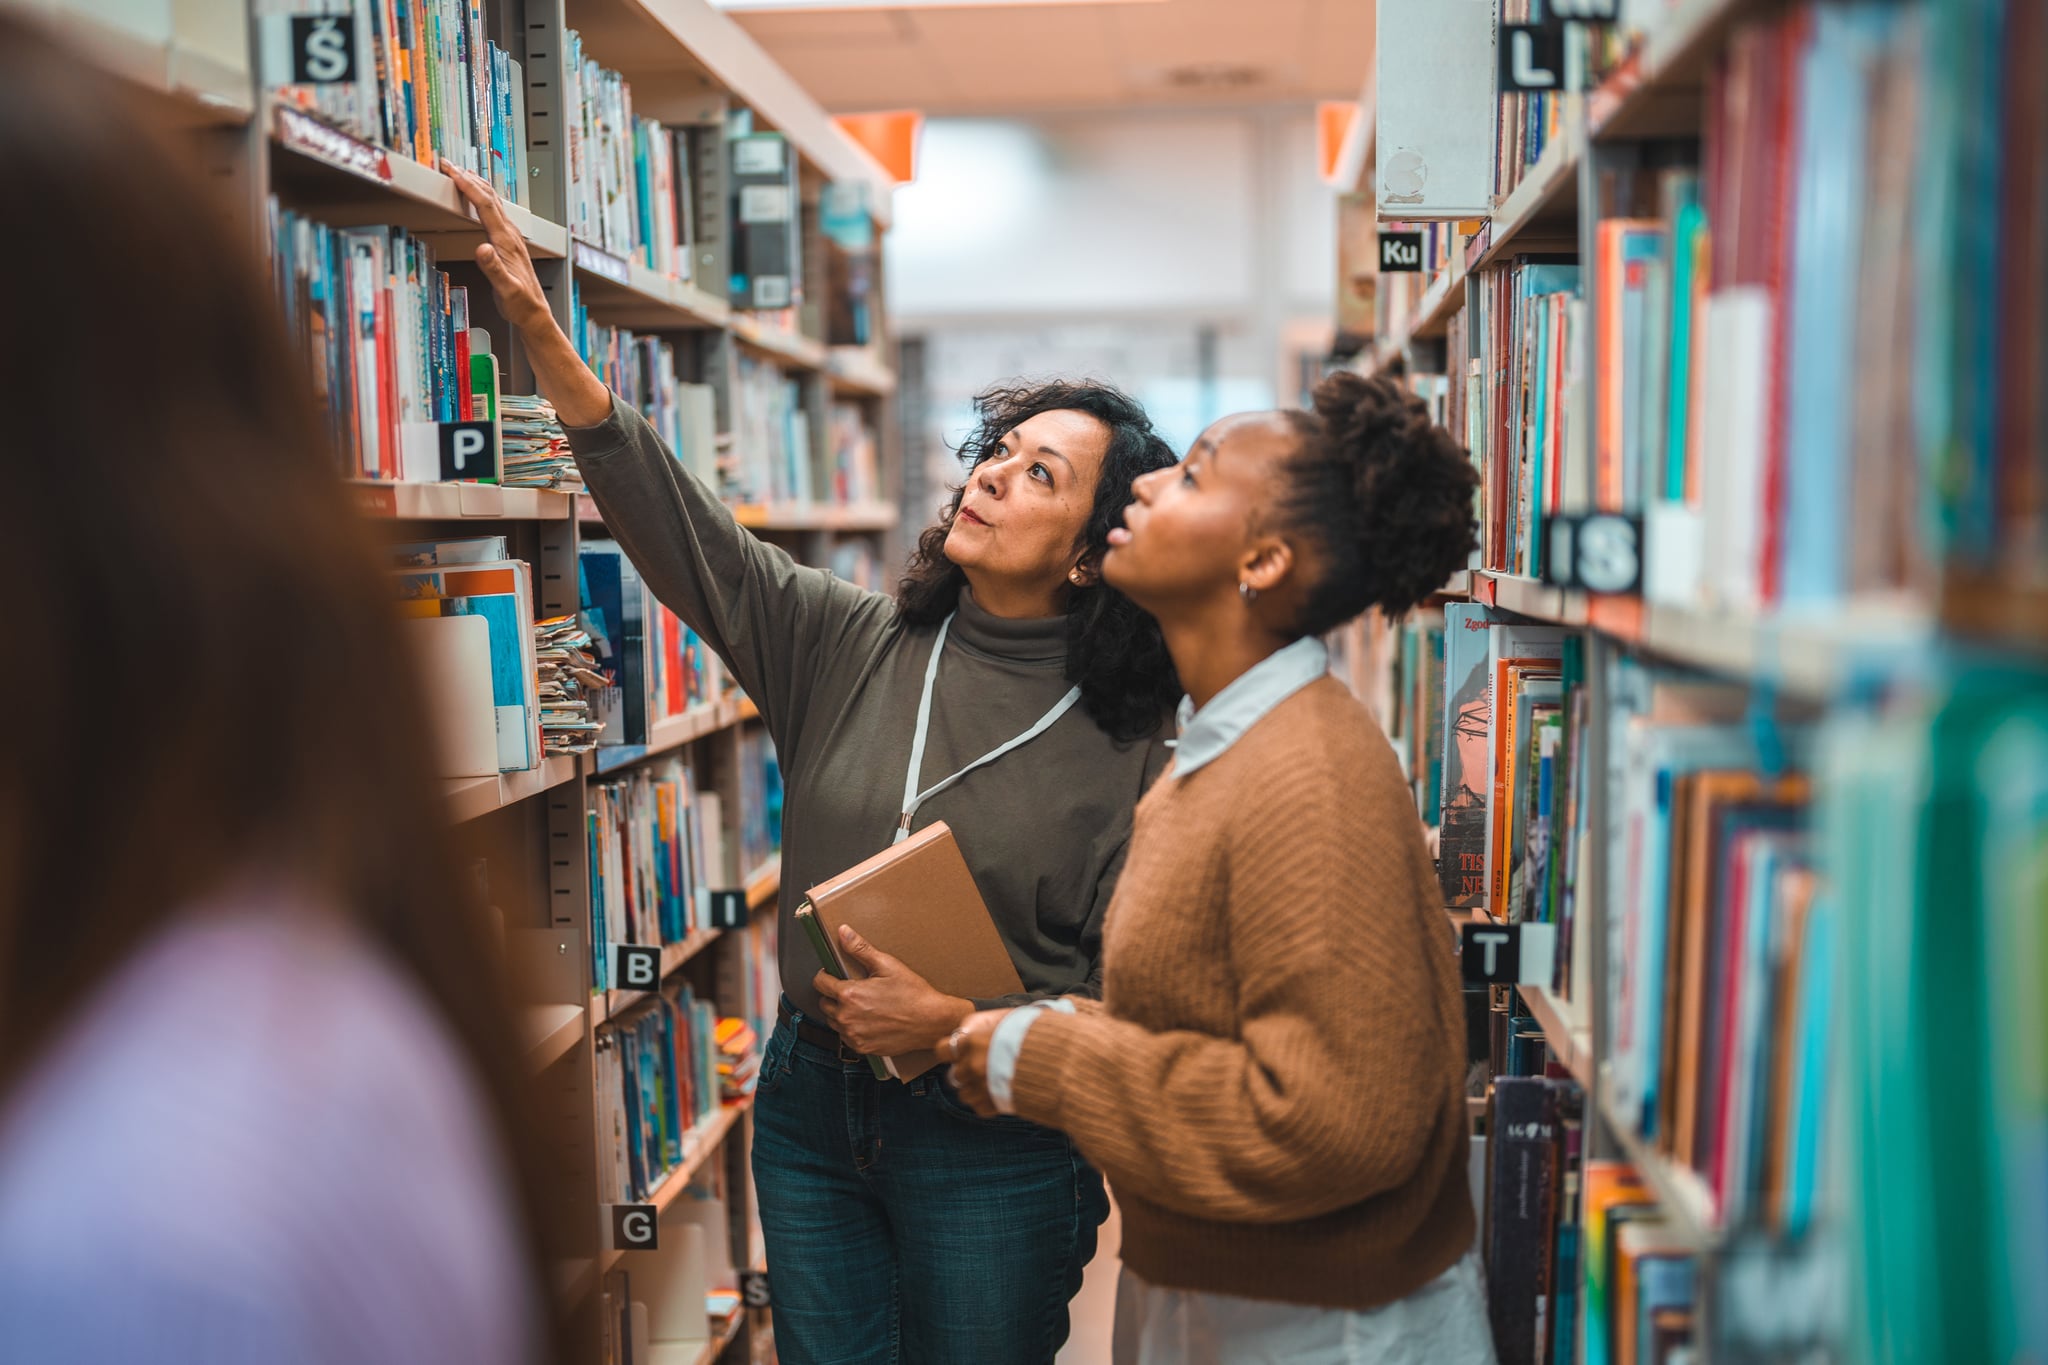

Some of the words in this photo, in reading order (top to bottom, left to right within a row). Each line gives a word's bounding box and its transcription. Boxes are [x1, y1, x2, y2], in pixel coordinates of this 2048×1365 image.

[304, 18, 348, 80] Š
[1511, 29, 1556, 88] L
[1383, 239, 1418, 265] Ku
[453, 428, 485, 471] P
[724, 894, 736, 927] I
[627, 953, 654, 984] B
[1472, 932, 1510, 976] T
[622, 1211, 652, 1243] G
